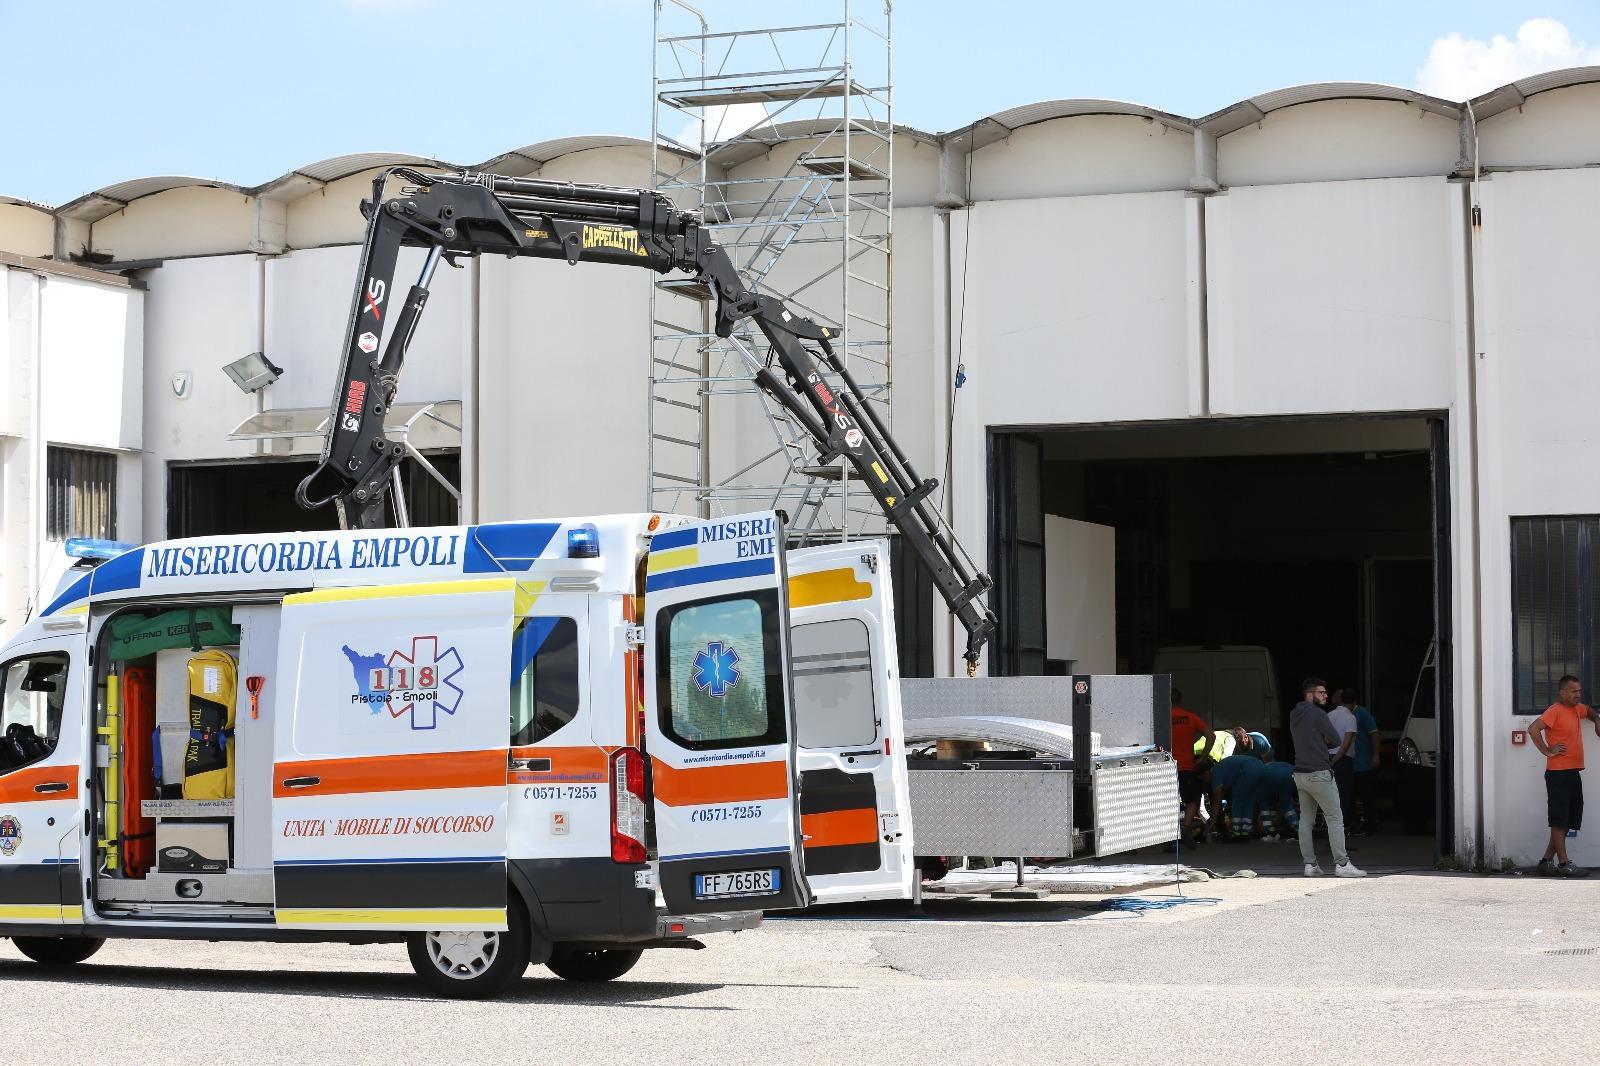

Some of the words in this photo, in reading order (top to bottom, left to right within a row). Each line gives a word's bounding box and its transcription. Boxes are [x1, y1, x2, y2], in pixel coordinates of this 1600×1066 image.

[583, 225, 639, 254] CAPPELLETTI
[148, 540, 344, 577] MISERICORDIA
[349, 535, 460, 568] EMPOLI
[374, 667, 434, 689] 118
[351, 693, 392, 704] Pistoia
[403, 690, 438, 702] Empoli
[683, 751, 766, 764] www.misericordia.empoli.fi.it
[532, 786, 597, 799] 0571-7255
[700, 805, 762, 822] 0571-7255
[334, 818, 393, 836] MOBILE
[392, 816, 413, 834] DI
[413, 814, 495, 834] SOCCORSO
[704, 875, 721, 893] FF
[727, 872, 771, 891] 765RS
